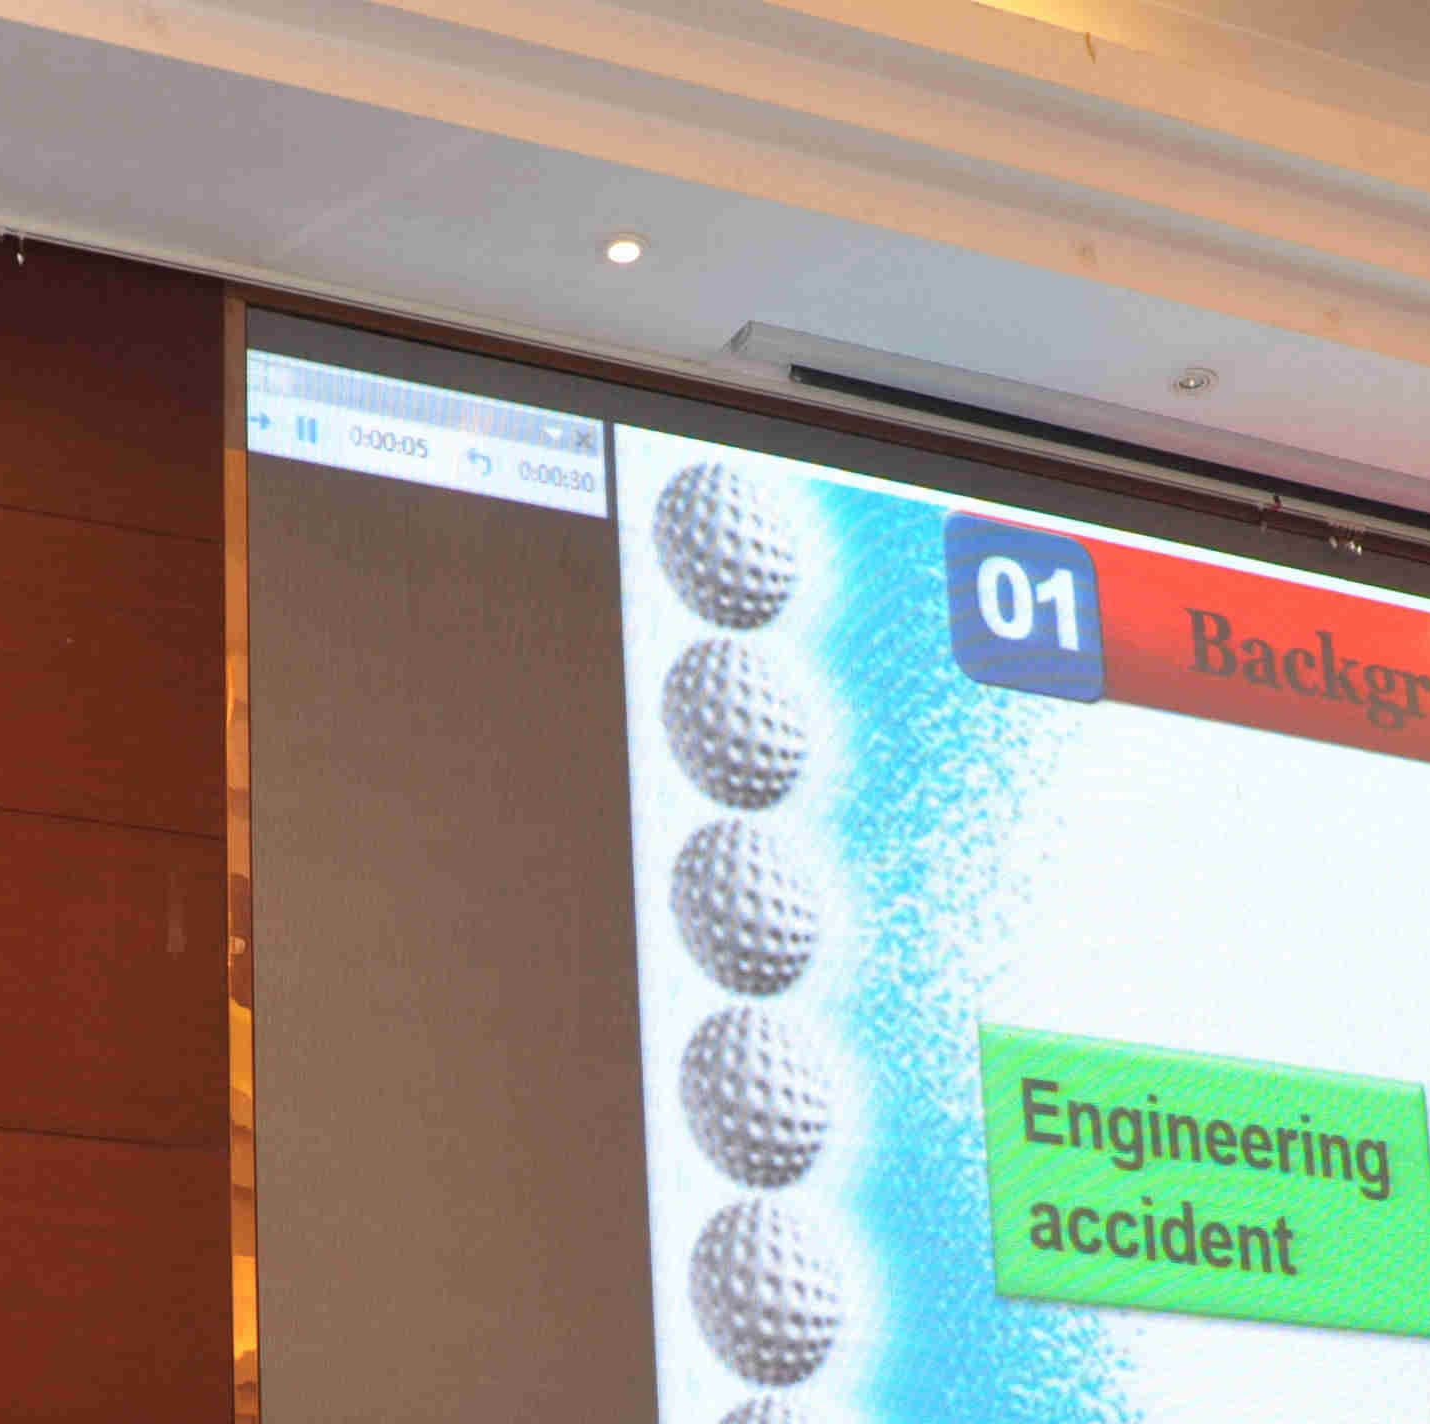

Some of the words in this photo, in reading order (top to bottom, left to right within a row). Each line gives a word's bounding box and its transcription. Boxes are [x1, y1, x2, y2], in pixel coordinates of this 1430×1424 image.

[350, 425, 428, 459] 0:00:05
[519, 460, 595, 492] 0:00:30
[977, 556, 1081, 652] 01
[1021, 1078, 1392, 1199] Engineering
[1029, 1197, 1297, 1277] accident
